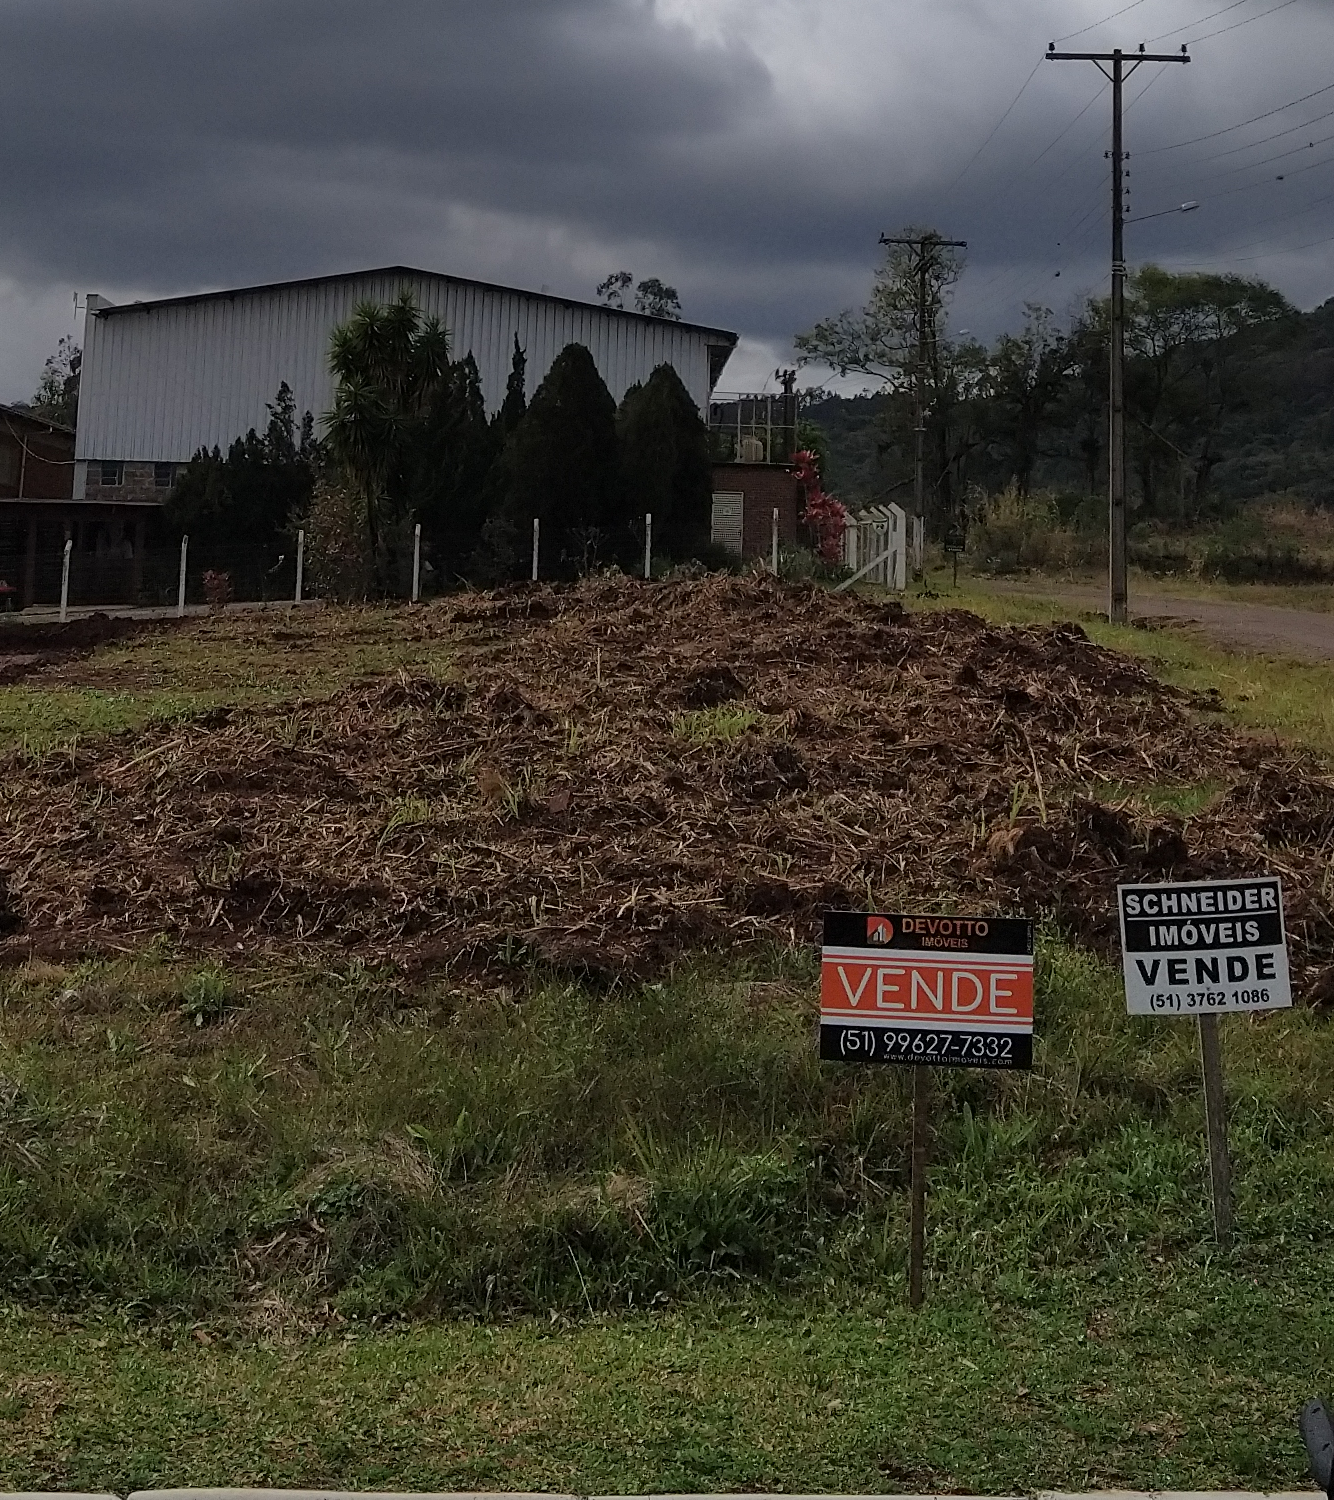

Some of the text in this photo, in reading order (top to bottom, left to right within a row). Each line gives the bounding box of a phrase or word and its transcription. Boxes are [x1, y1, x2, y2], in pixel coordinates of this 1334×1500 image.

[1124, 887, 1278, 915] SCHNEIDER
[901, 917, 990, 938] DEVOTTO
[1148, 919, 1261, 947] IMÓVEIS
[921, 935, 970, 949] IMÓVEIS
[1134, 952, 1277, 987] VENDE
[836, 965, 1019, 1015] VENDE
[1149, 988, 1271, 1012] (51) 3762 1086
[840, 1029, 1013, 1059] (51) 99627-7332
